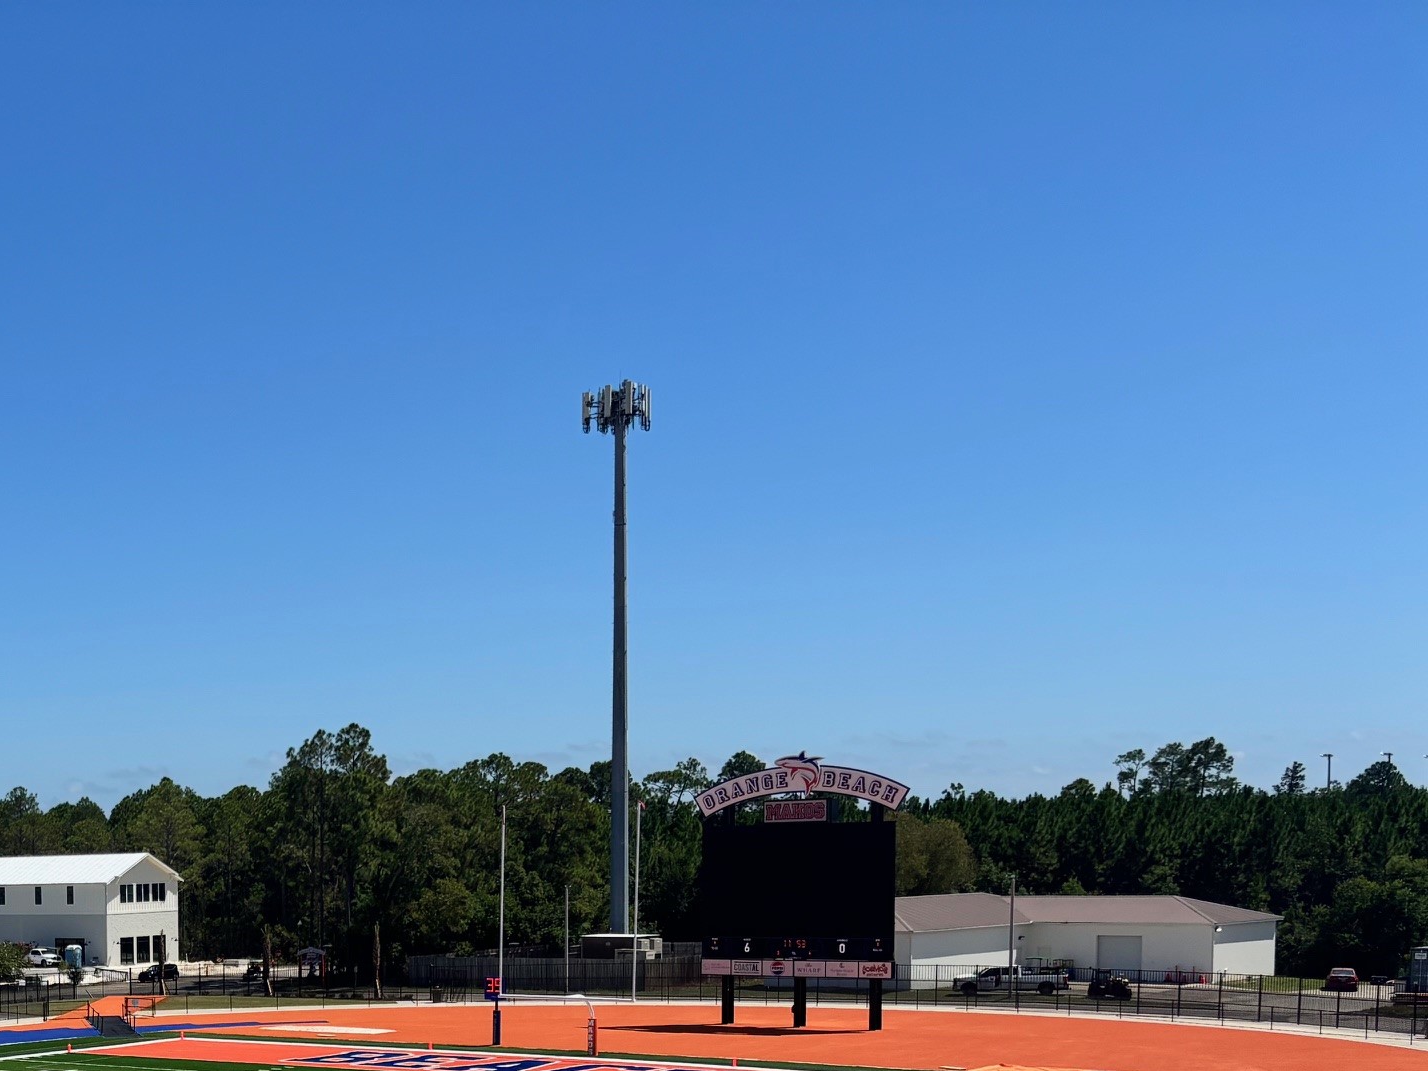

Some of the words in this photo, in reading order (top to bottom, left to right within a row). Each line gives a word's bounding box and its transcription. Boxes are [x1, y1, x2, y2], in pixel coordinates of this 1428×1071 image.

[703, 772, 788, 810] ORANGE
[822, 771, 899, 805] BEACH
[765, 803, 826, 820] MAKOS
[744, 942, 750, 953] 6
[838, 943, 846, 954] 0
[733, 963, 760, 972] COASTAL
